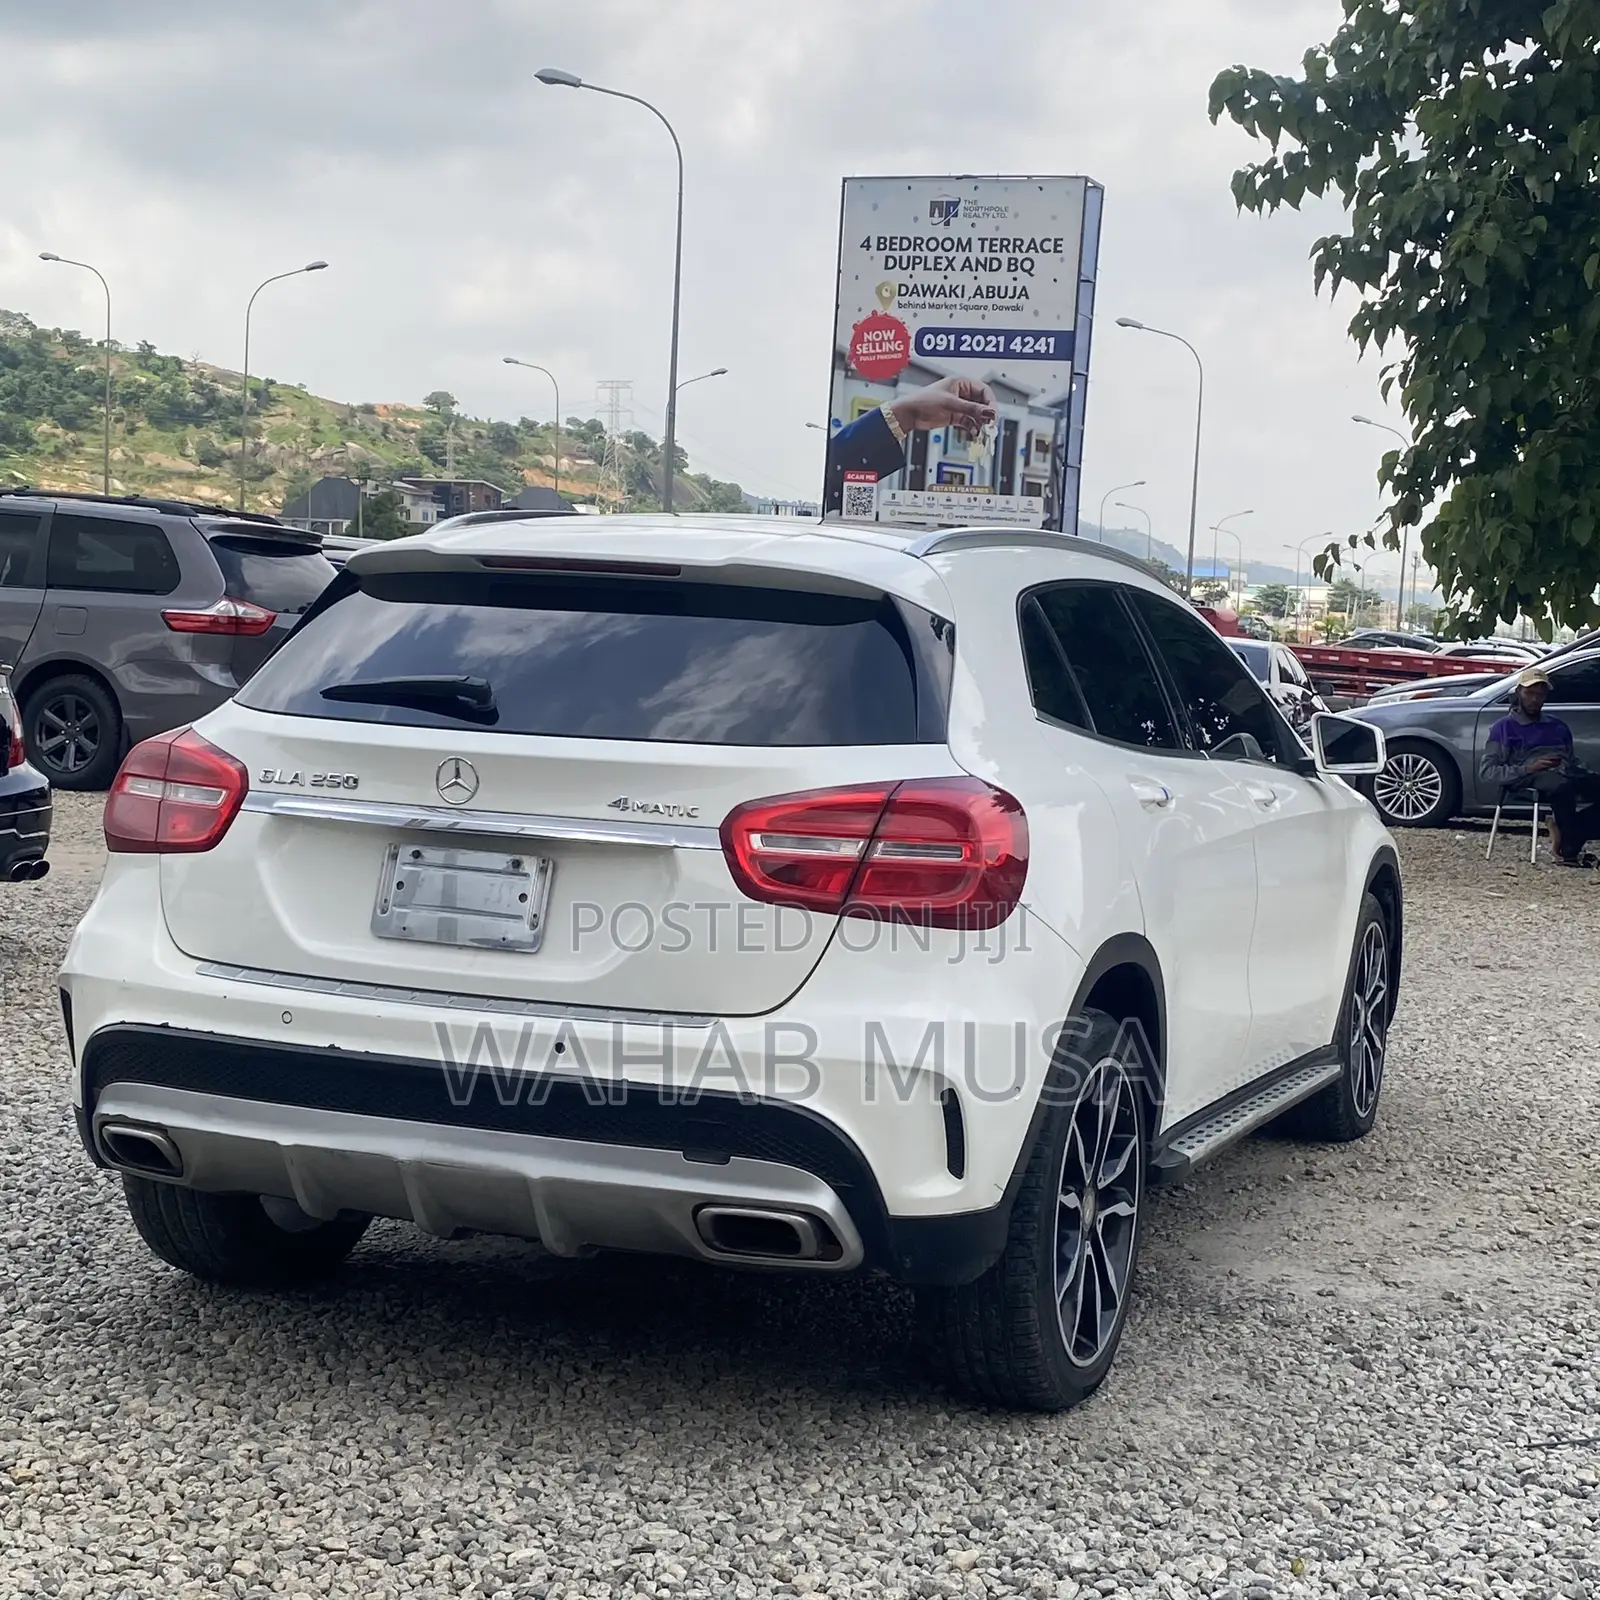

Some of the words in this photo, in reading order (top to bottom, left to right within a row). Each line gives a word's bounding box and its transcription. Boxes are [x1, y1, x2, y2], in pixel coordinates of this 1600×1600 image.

[860, 236, 872, 252] 4
[876, 236, 972, 254] BEDROOM
[977, 237, 1064, 255] TERRACE
[884, 255, 958, 273] DUPLEX
[959, 256, 1002, 273] AND
[1007, 257, 1035, 277] BQ
[897, 283, 965, 299] DAWAKI
[897, 301, 926, 310] behind
[928, 302, 958, 311] Market
[959, 303, 990, 313] Square,
[992, 303, 1024, 312] Dawaki
[863, 329, 895, 342] NOW
[922, 333, 955, 351] 091
[960, 334, 1004, 353] 2021
[1009, 336, 1056, 354] 4241
[856, 340, 904, 355] SELLING
[957, 486, 989, 494] FEATURES
[259, 768, 305, 787] GLA
[309, 772, 359, 790] 250
